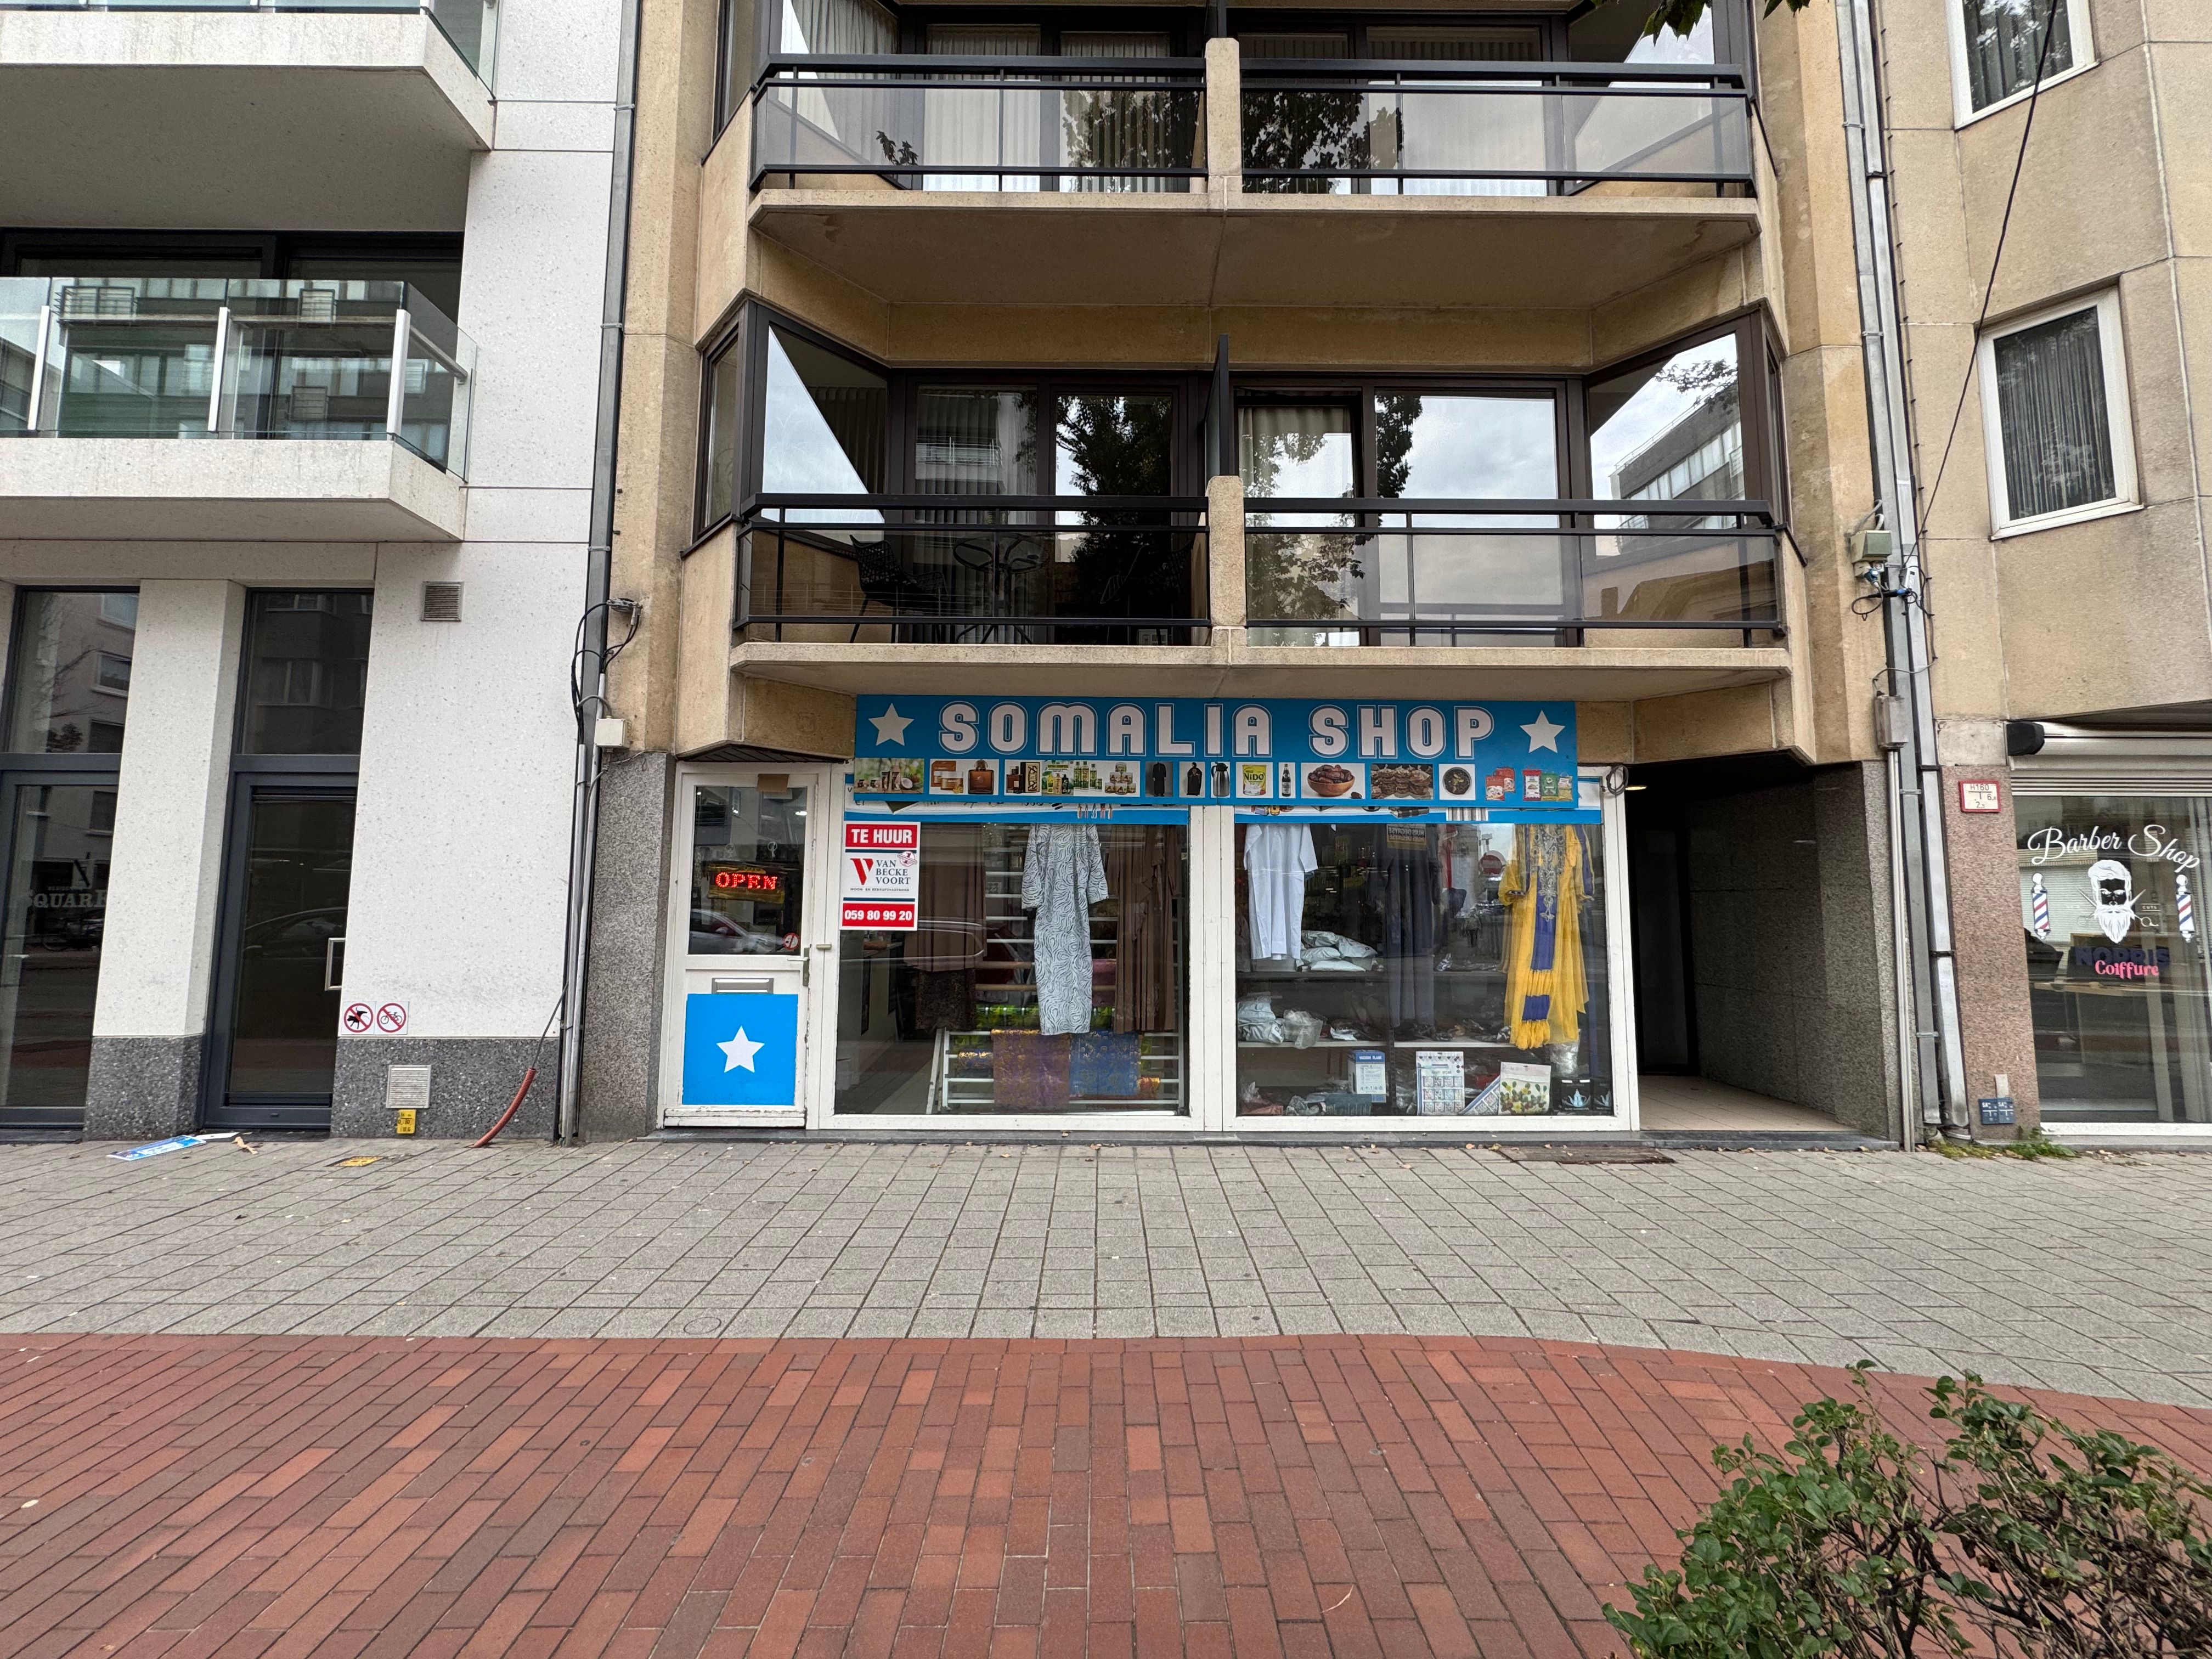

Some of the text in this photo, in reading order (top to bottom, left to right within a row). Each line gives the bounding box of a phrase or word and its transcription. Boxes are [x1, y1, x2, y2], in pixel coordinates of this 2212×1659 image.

[938, 700, 1495, 760] SOMALIA SHOP
[851, 828, 912, 844] TE HUUR
[2027, 825, 2200, 873] Barber Shop
[876, 860, 897, 868] VAN
[876, 868, 909, 876] BECKE
[715, 871, 778, 890] OPEN
[876, 877, 911, 885] VOORT
[844, 910, 913, 922] 059 80 99 20
[2094, 960, 2160, 980] Coiffure
